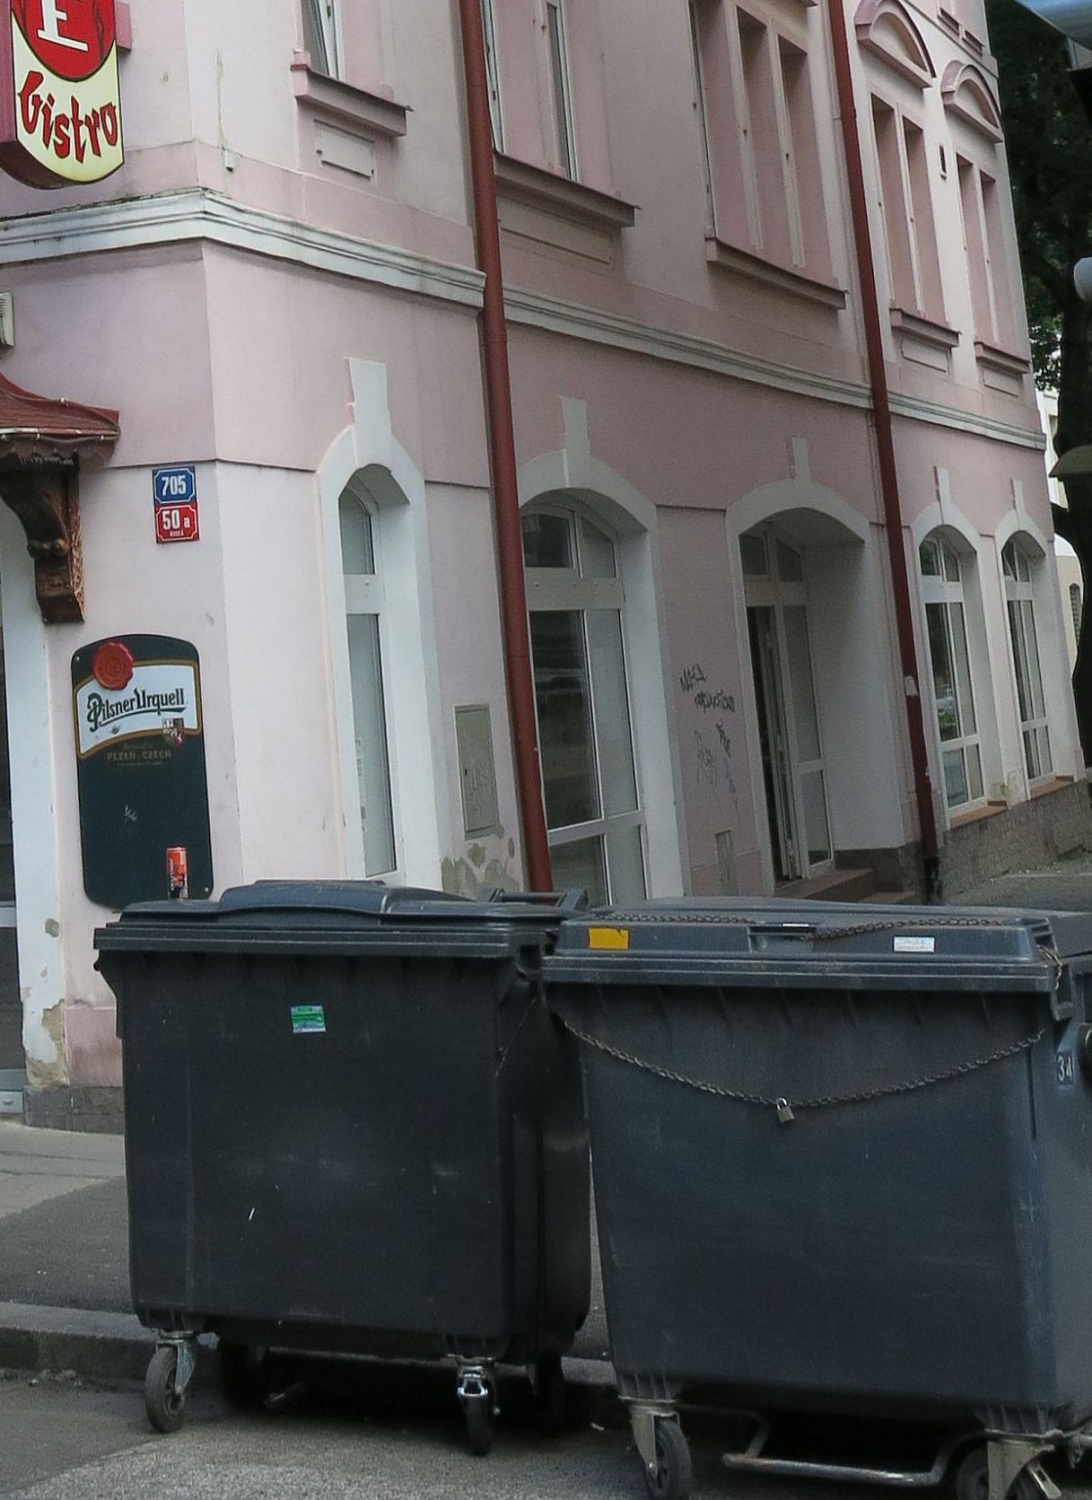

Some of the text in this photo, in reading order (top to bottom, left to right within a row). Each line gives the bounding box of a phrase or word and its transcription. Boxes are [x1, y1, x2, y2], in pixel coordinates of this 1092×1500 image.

[161, 474, 187, 496] 705
[162, 509, 181, 530] 50
[87, 687, 185, 732] Pilsner Urquell
